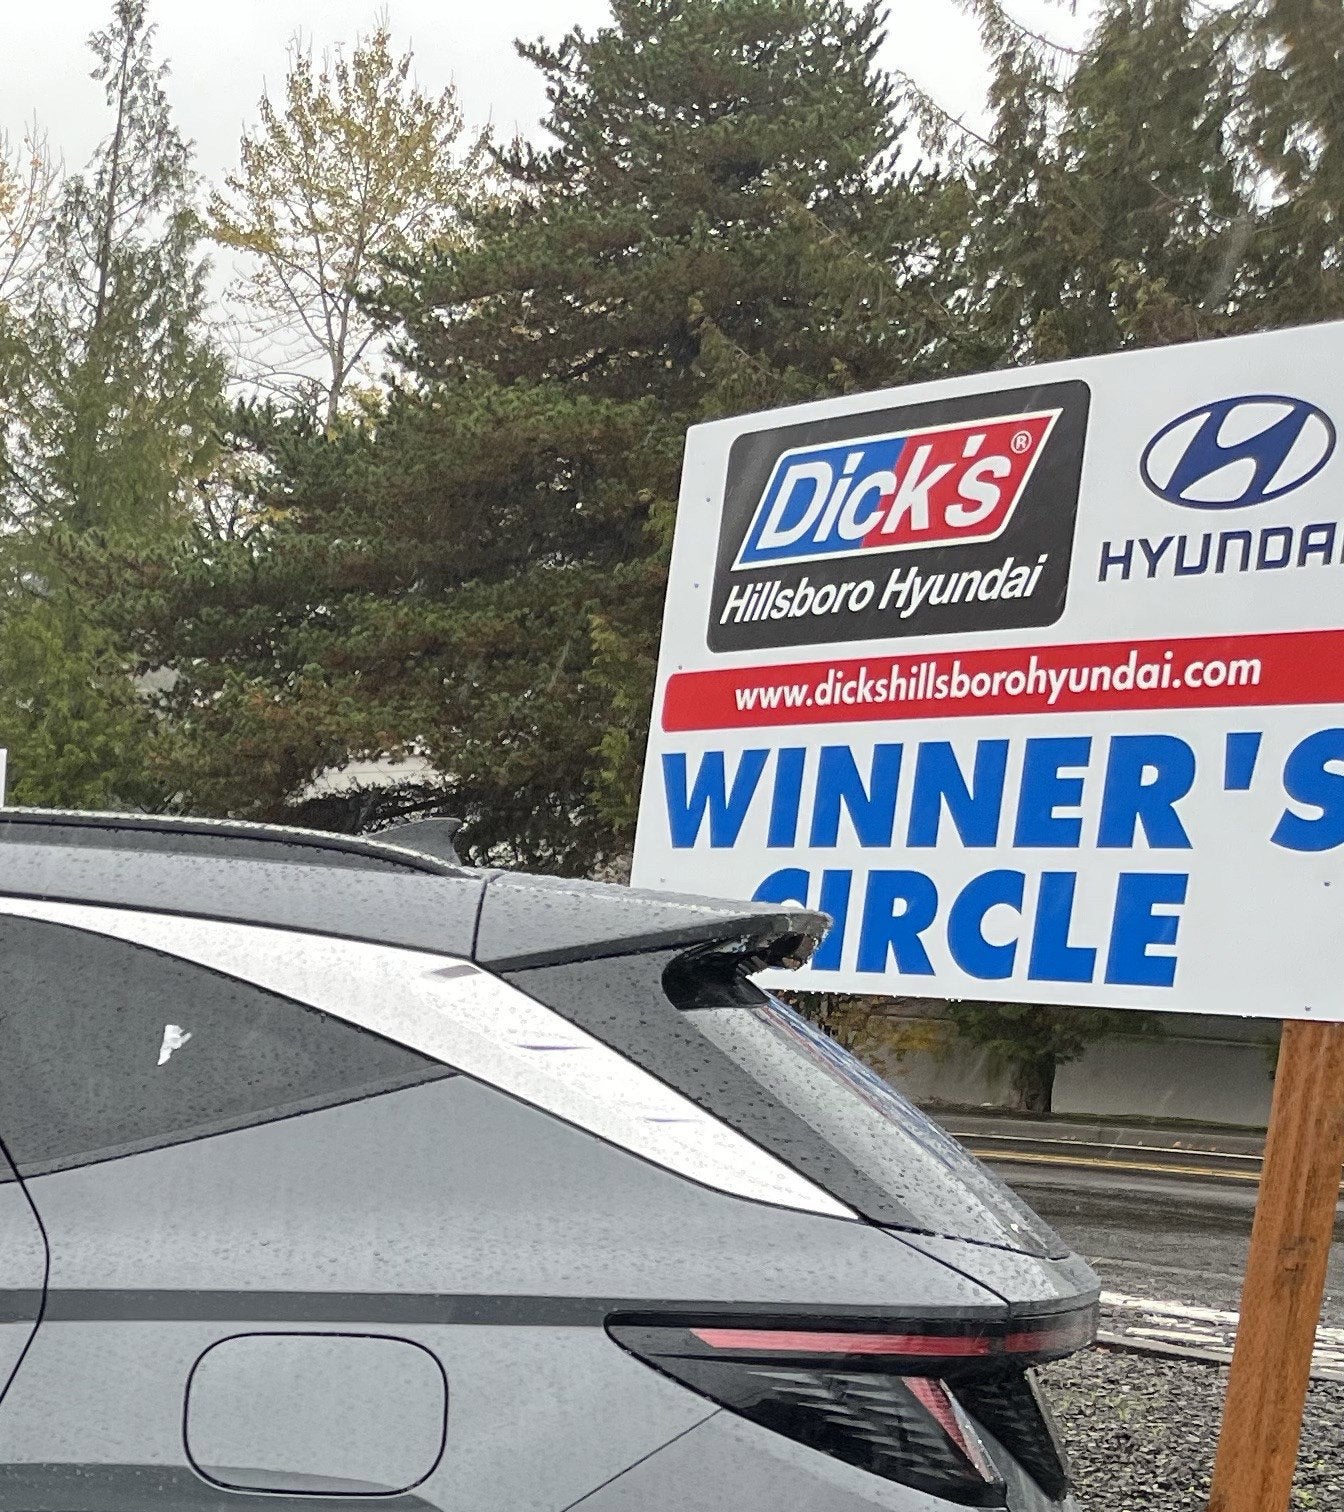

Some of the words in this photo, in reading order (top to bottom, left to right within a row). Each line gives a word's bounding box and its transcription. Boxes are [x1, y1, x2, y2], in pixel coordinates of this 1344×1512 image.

[755, 434, 1014, 551] Dick's
[719, 574, 875, 625] Hillsboro
[878, 553, 1049, 619] Hyundai
[735, 650, 1262, 711] www.dickshillsborohyundai.com
[662, 728, 1344, 852] WINNER'S
